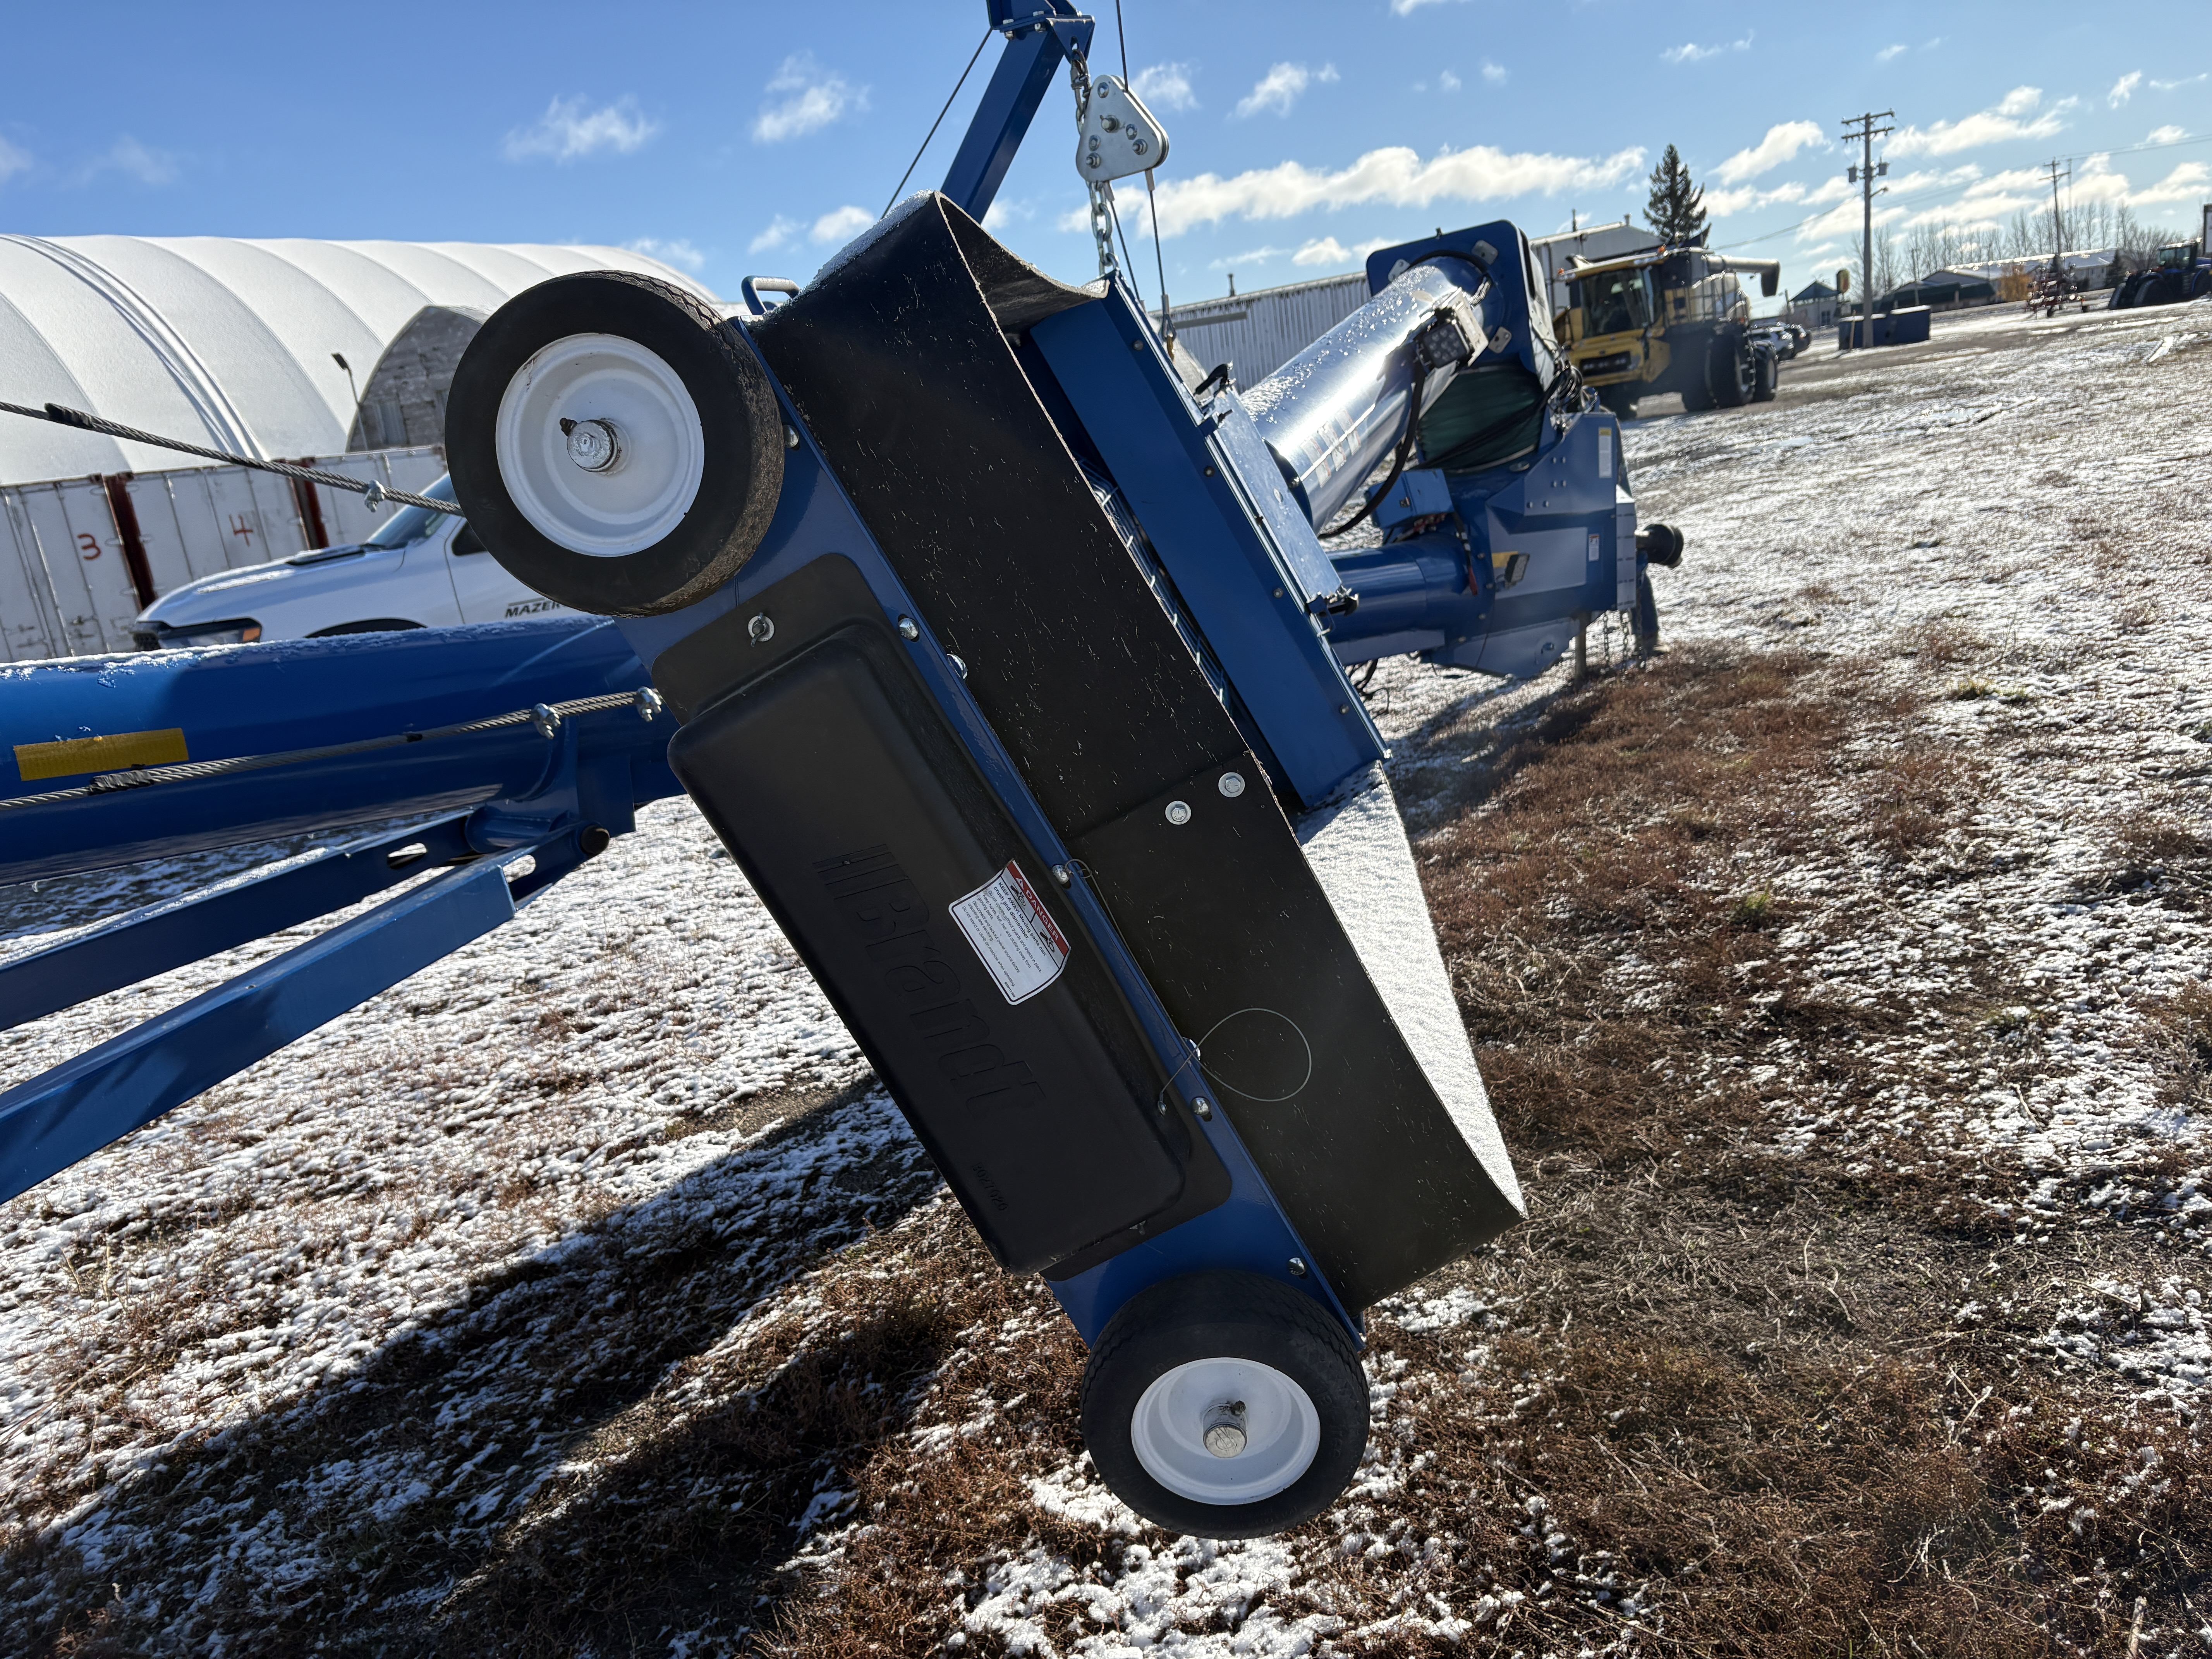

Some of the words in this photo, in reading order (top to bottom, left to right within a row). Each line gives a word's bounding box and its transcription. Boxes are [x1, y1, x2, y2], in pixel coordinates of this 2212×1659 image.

[77, 532, 101, 560] 3
[228, 514, 254, 547] 4
[968, 903, 979, 919] adjusting
[982, 925, 993, 942] servicing.
[977, 897, 988, 910] moving
[994, 886, 1004, 901] crush
[1003, 901, 1012, 911] and
[1010, 911, 1029, 940] dismember.
[998, 882, 1009, 896] KEEP
[1007, 897, 1020, 914] AWAY!
[1018, 914, 1031, 933] Moving
[1030, 933, 1039, 946] parts
[1026, 890, 1058, 940] DANGER
[969, 918, 978, 928] stand
[988, 946, 999, 961] machine
[1004, 970, 1015, 988] operating.
[972, 900, 986, 920] Disconnect
[989, 926, 999, 939] lockout
[996, 939, 1006, 950] power
[1004, 950, 1013, 962] source
[1012, 962, 1020, 973] before
[995, 902, 1005, 916] operate
[1012, 928, 1021, 940] guards
[1024, 947, 1033, 959] shields
[1010, 937, 1020, 951] clothing
[833, 875, 1047, 1123] Brandt
